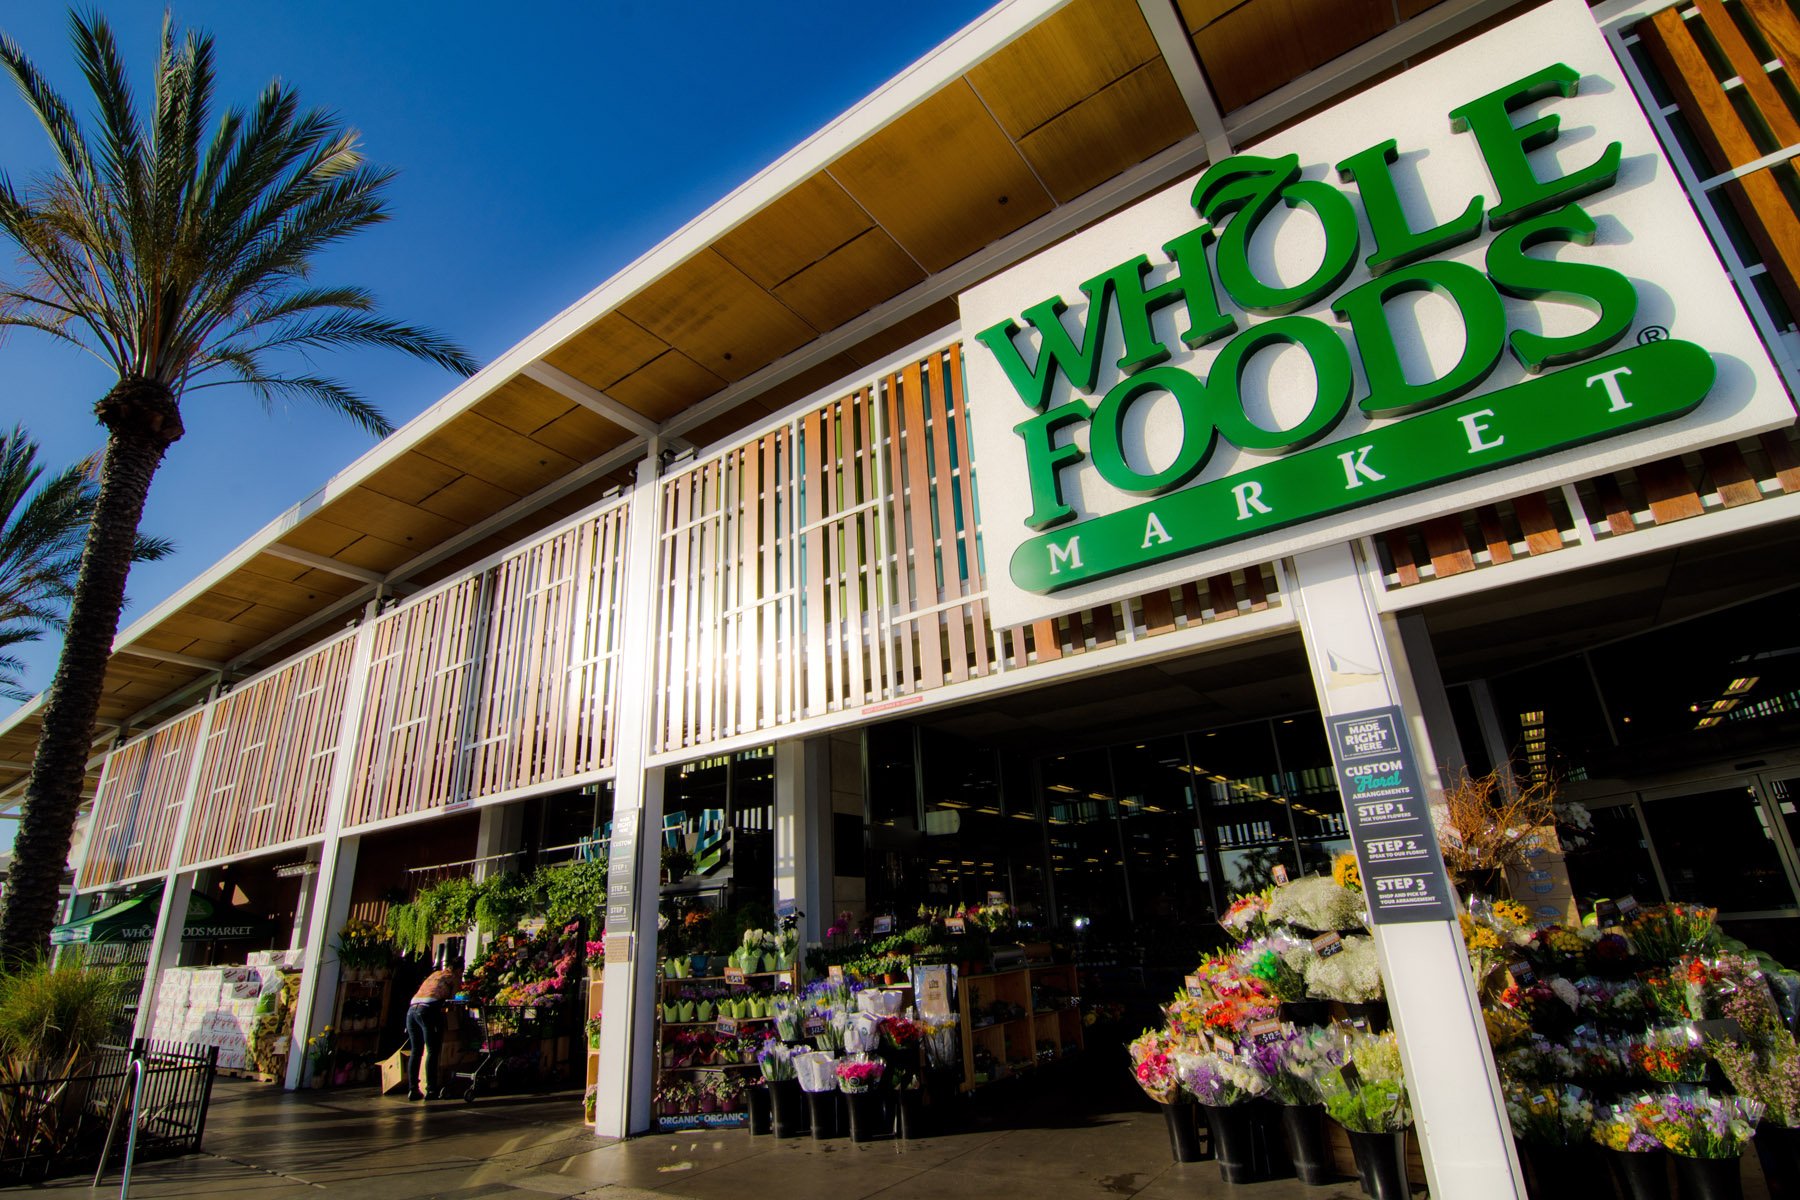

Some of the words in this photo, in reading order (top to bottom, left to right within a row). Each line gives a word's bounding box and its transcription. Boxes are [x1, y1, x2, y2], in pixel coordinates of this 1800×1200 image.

[975, 62, 1622, 413] WHOLE
[1012, 203, 1639, 531] FOODS
[1048, 366, 1632, 576] MARKET
[1348, 722, 1380, 735] MADE
[1345, 730, 1388, 746] RIGHT
[1354, 740, 1384, 753] HERE
[1345, 760, 1403, 777] CUSTOM
[1354, 771, 1402, 793] Floral
[1352, 786, 1410, 800] ARRANGEMENTS
[1358, 803, 1394, 818] STEP
[1396, 804, 1404, 812] 1
[1387, 812, 1412, 820] FLOWERS
[1366, 840, 1404, 854] STEP
[1406, 840, 1417, 850] 2
[1376, 877, 1413, 892] STEP
[1416, 878, 1426, 891] 3
[122, 924, 154, 938] WHO
[182, 926, 205, 937] ODS
[206, 926, 254, 937] MARKET
[659, 1115, 699, 1125] ORGANIC
[704, 1112, 744, 1123] ORGANIC
